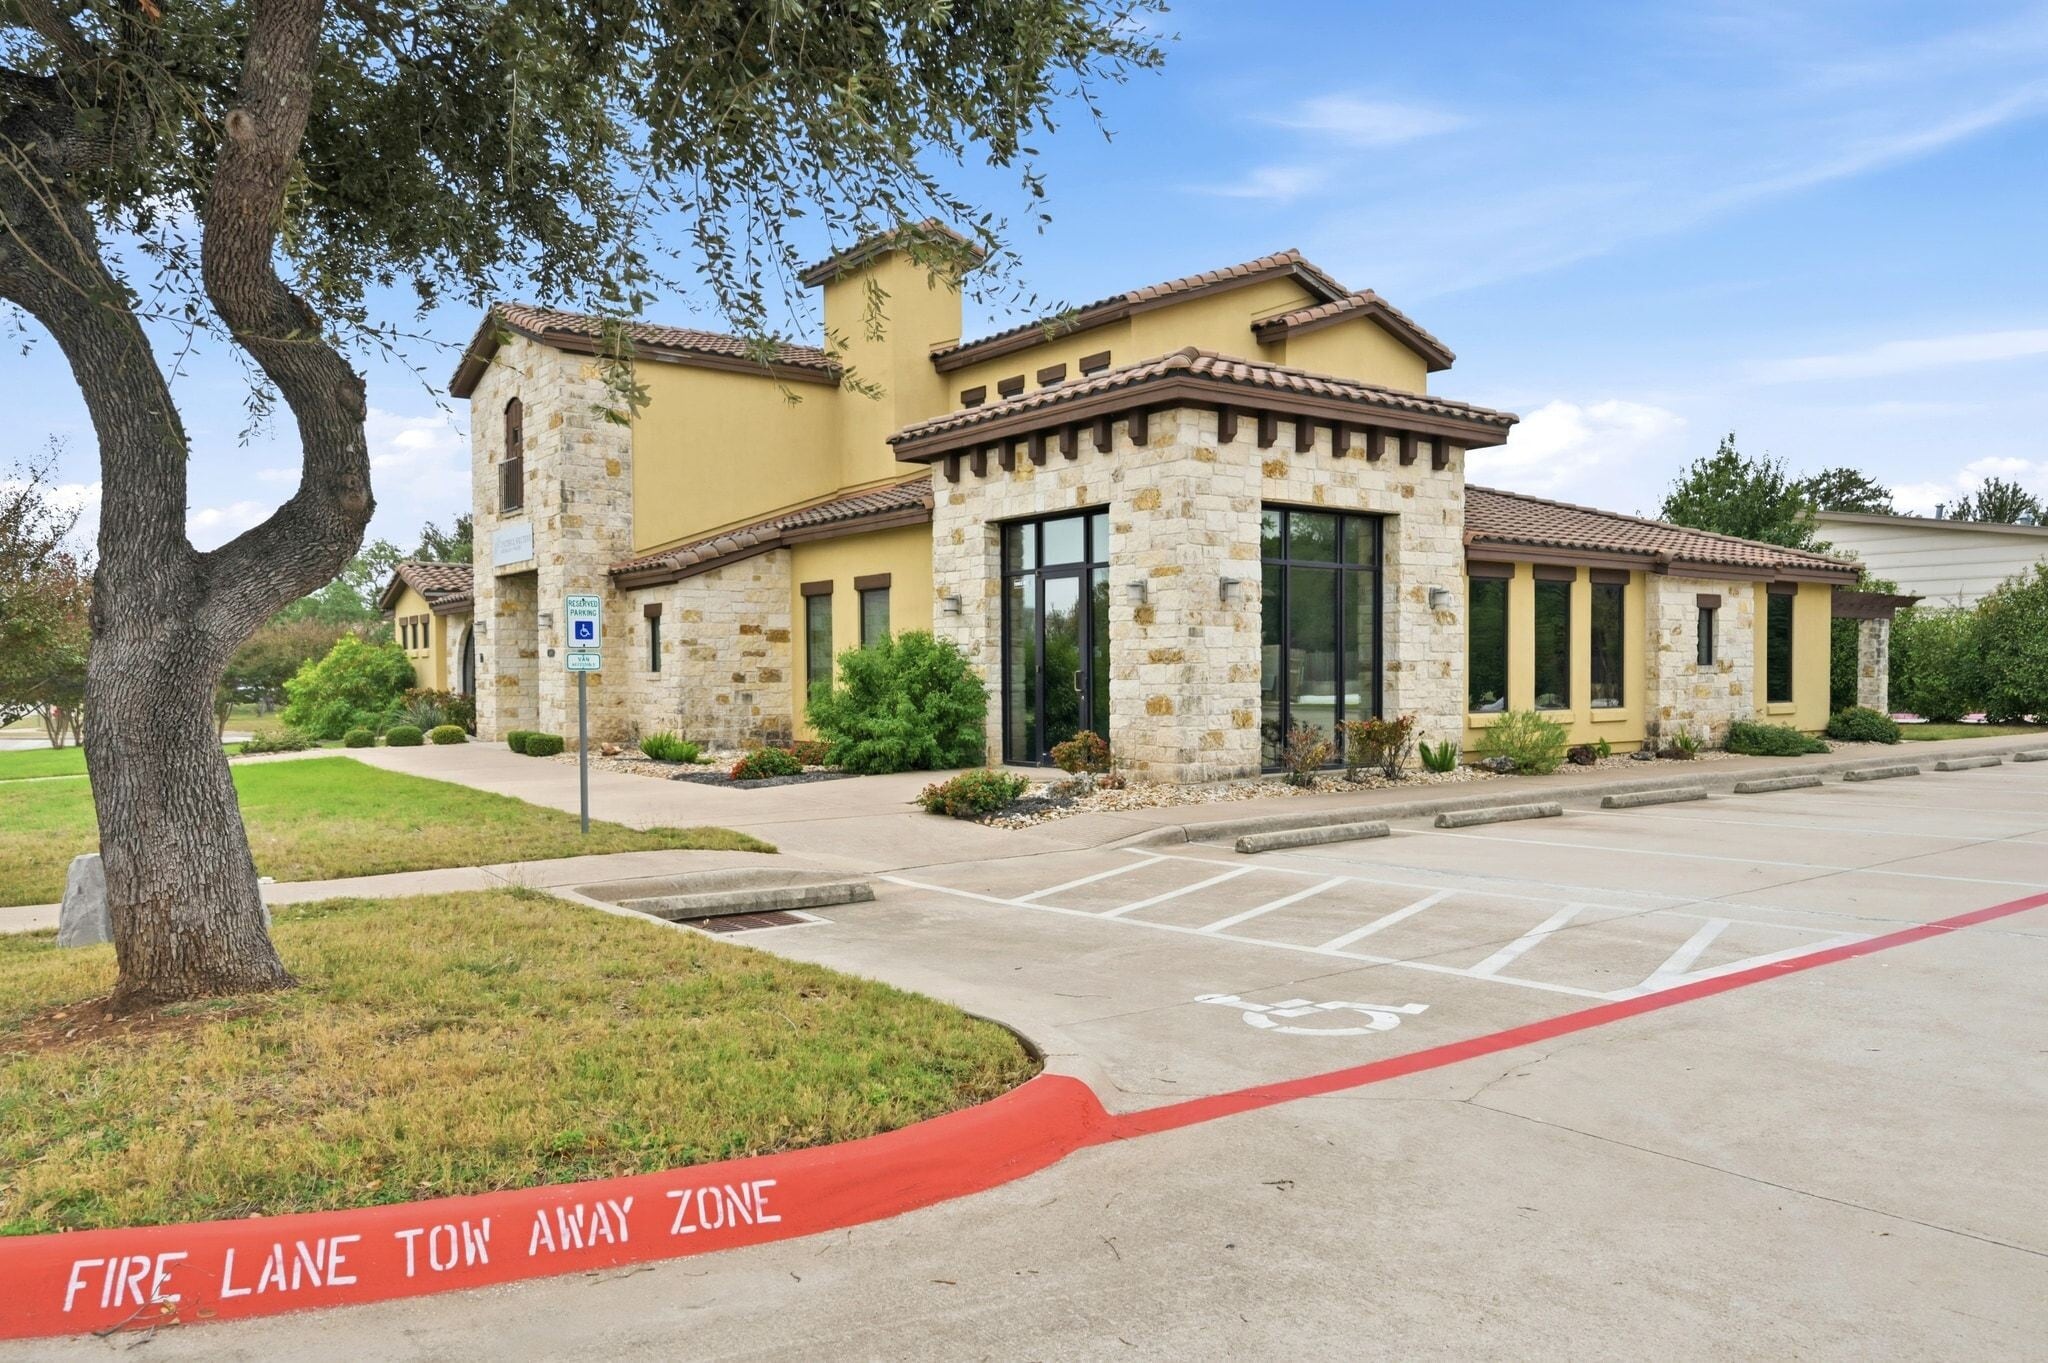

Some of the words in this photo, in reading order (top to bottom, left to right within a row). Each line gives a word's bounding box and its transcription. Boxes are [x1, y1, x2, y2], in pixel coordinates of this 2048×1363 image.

[568, 600, 598, 608] RESERVED
[62, 1250, 188, 1313] FIRE
[220, 1235, 361, 1299] LANE
[395, 1217, 491, 1277] TOW
[528, 1195, 634, 1256] AWAY
[665, 1179, 782, 1236] ZONE
